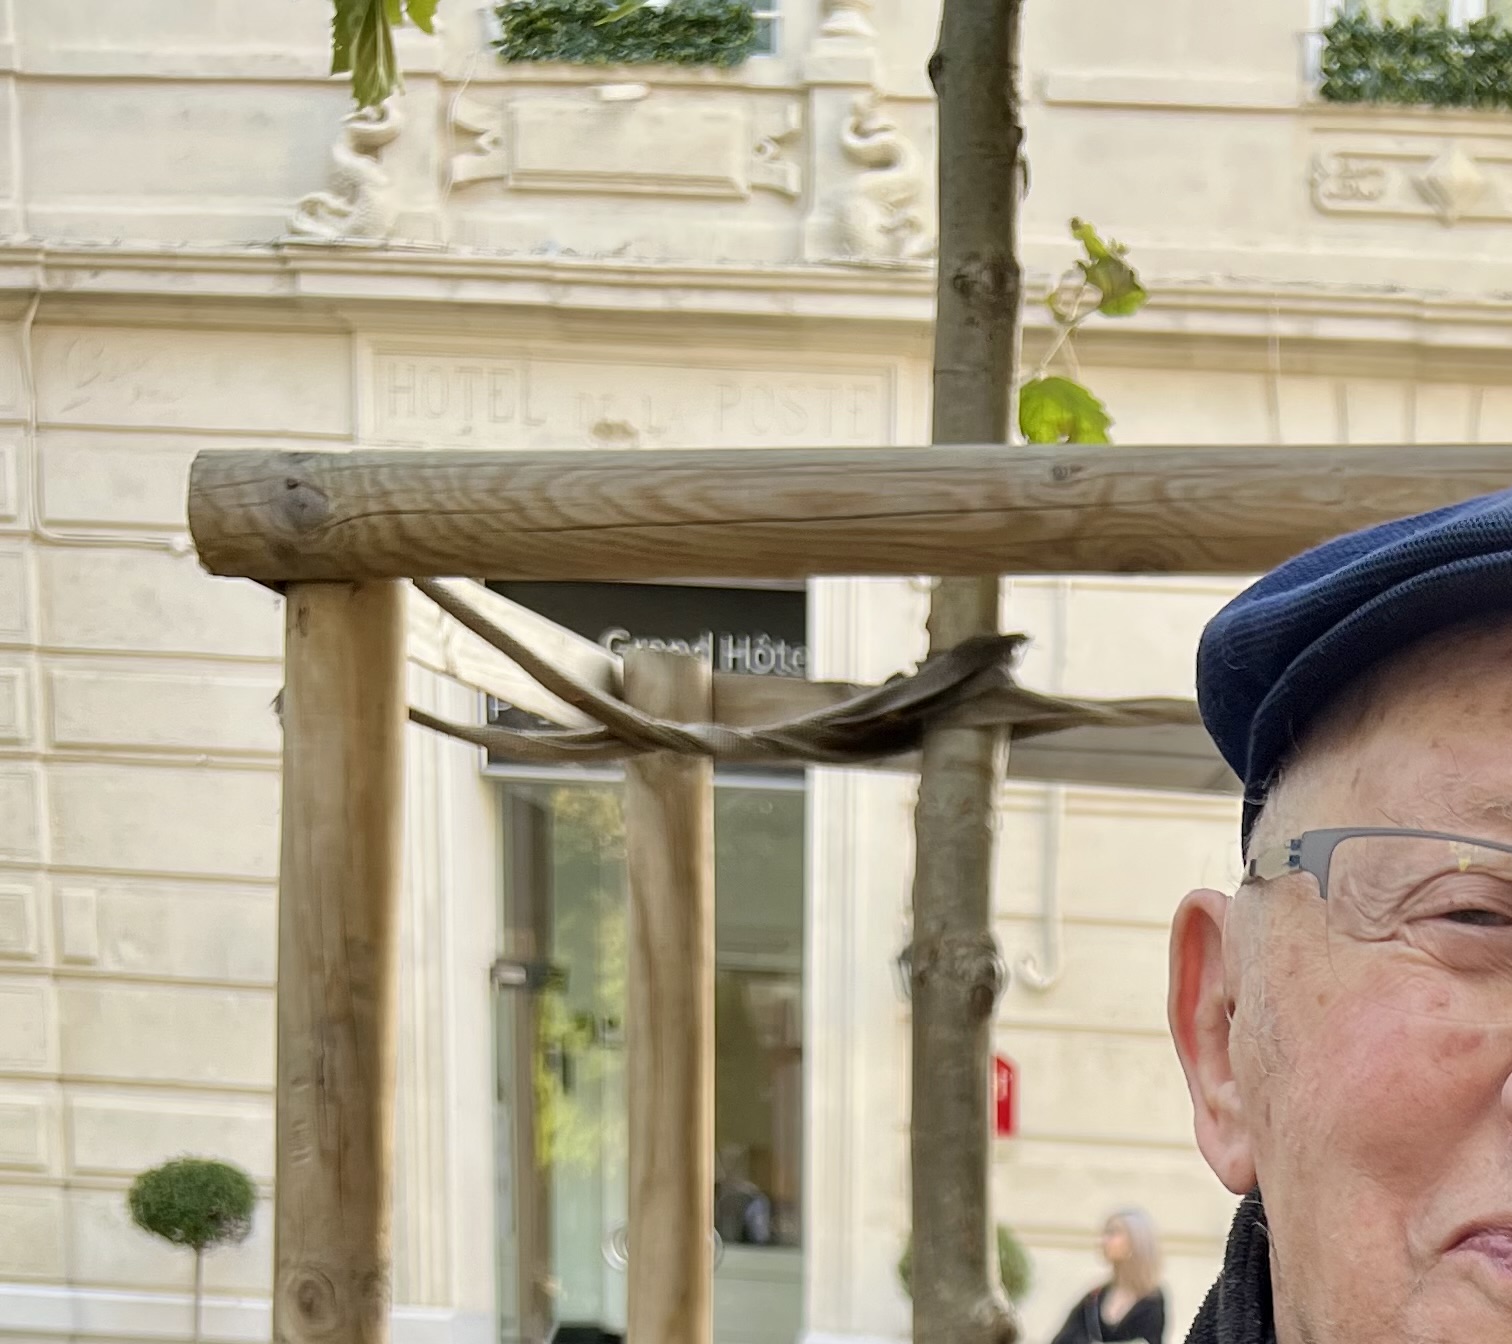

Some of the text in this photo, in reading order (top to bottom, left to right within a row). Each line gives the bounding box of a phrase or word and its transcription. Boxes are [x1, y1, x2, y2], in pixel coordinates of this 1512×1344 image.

[387, 363, 547, 427] HOTEL
[714, 382, 877, 438] POSTE
[720, 632, 807, 675] Hôte
